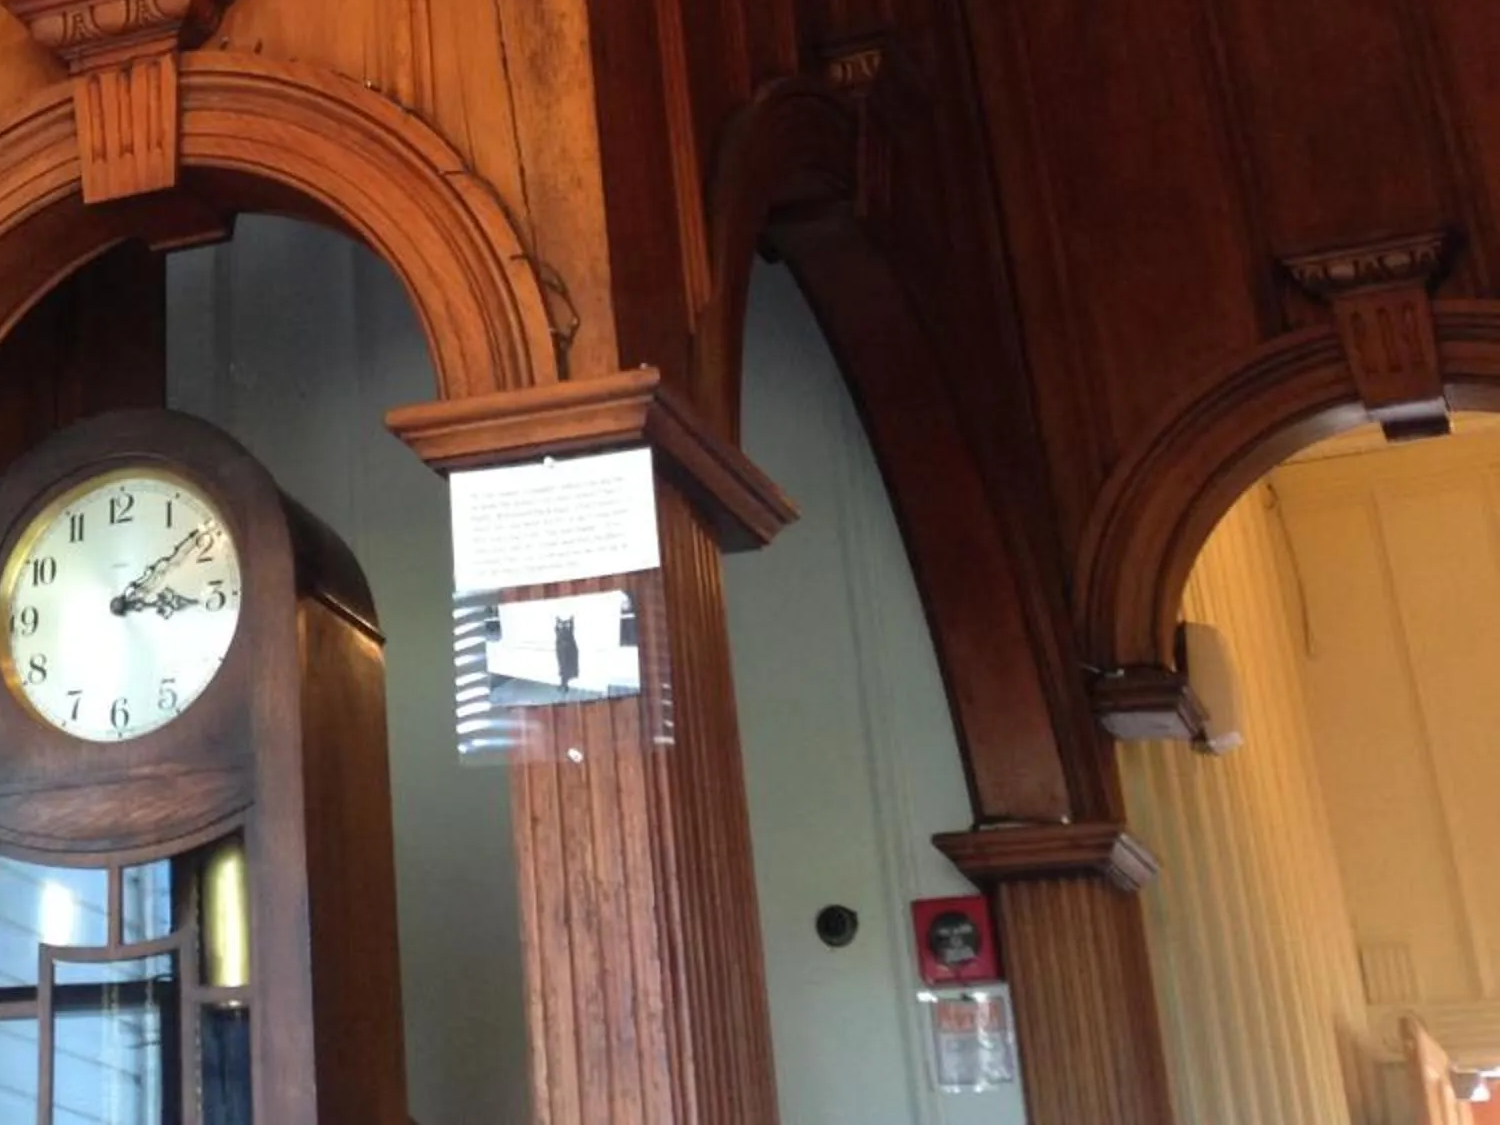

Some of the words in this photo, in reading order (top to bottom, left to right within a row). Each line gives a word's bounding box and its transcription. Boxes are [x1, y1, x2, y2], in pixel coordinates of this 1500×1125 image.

[108, 492, 135, 525] 12
[165, 500, 173, 529] 1
[68, 512, 85, 544] 11
[195, 530, 215, 564] 2
[32, 556, 57, 587] 10
[205, 579, 227, 612] 3
[20, 605, 40, 636] 9
[27, 652, 48, 685] 8
[66, 689, 84, 721] 7
[157, 677, 178, 711] 5
[109, 697, 130, 729] 6
